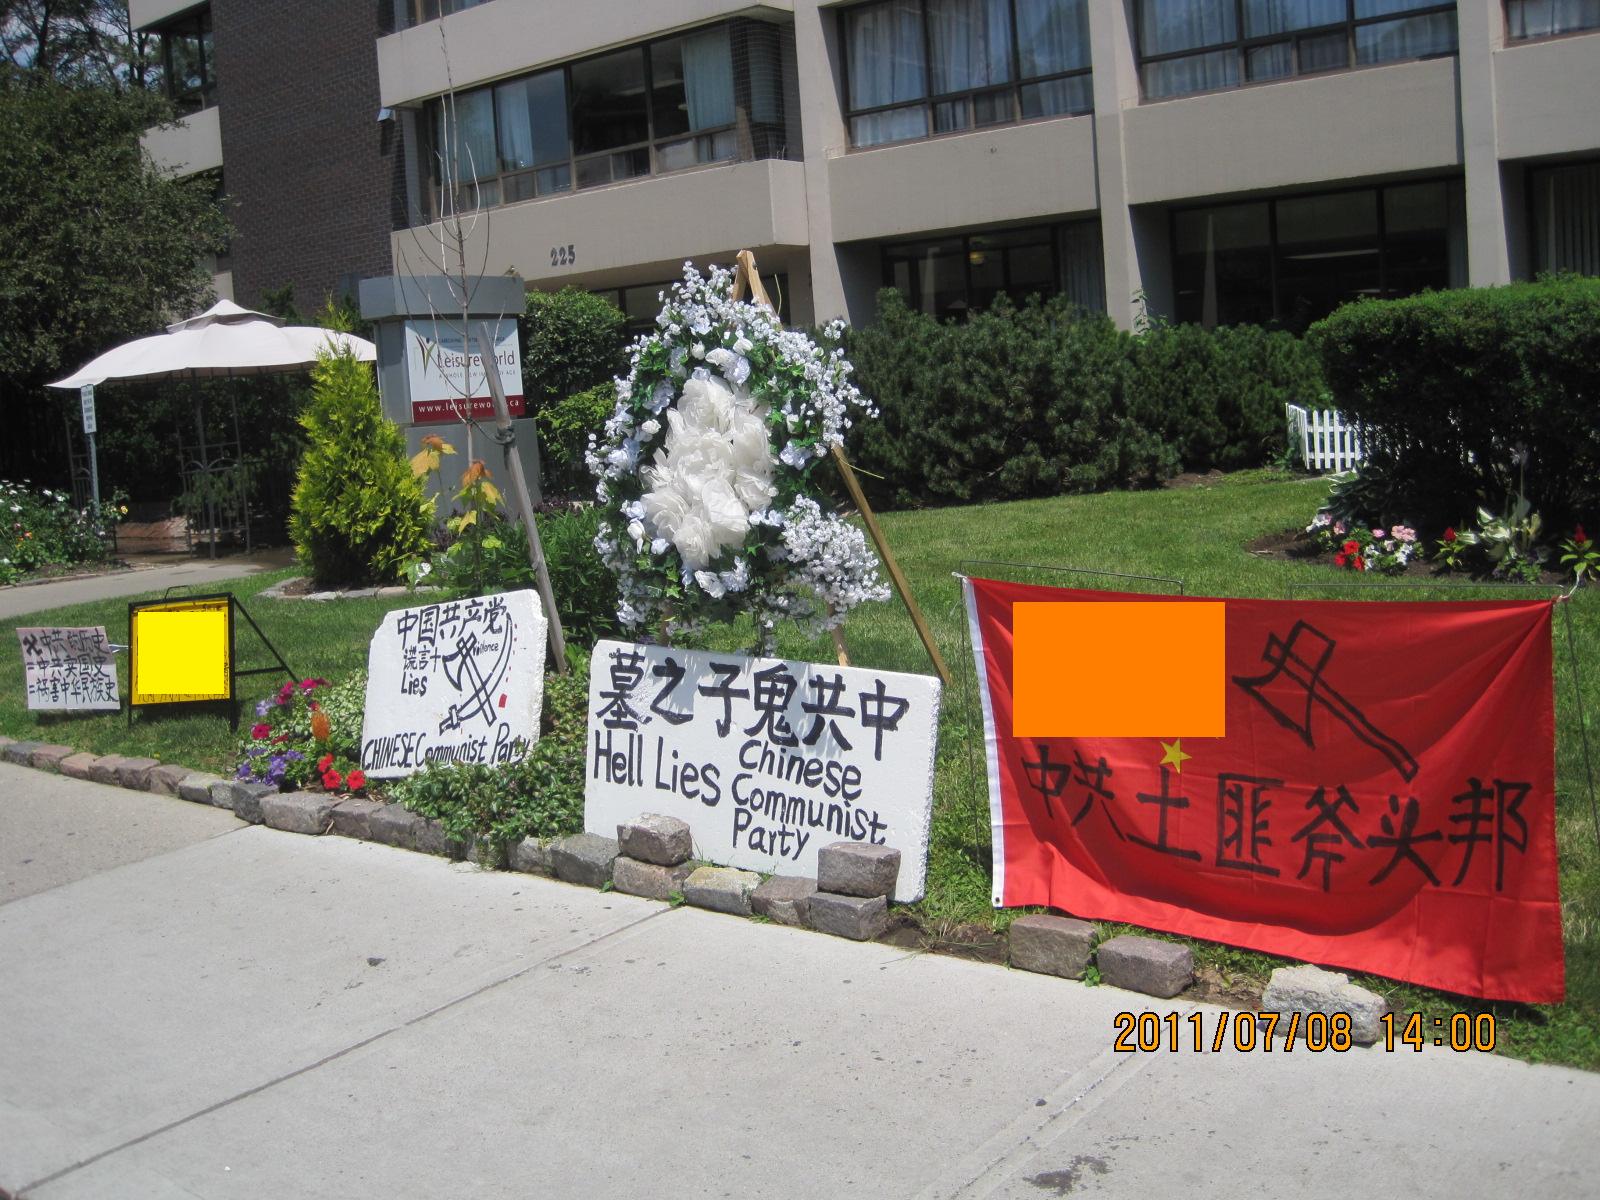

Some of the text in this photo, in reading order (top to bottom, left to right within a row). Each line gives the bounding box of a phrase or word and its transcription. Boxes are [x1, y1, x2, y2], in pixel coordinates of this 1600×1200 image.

[551, 244, 575, 266] 225
[397, 596, 507, 649] 中国共产党
[401, 671, 428, 697] Lies
[362, 732, 417, 771] CHINESE
[594, 729, 721, 807] Hell Lies
[739, 740, 863, 801] Chinese
[731, 773, 888, 846] Communist
[732, 807, 811, 861] Party
